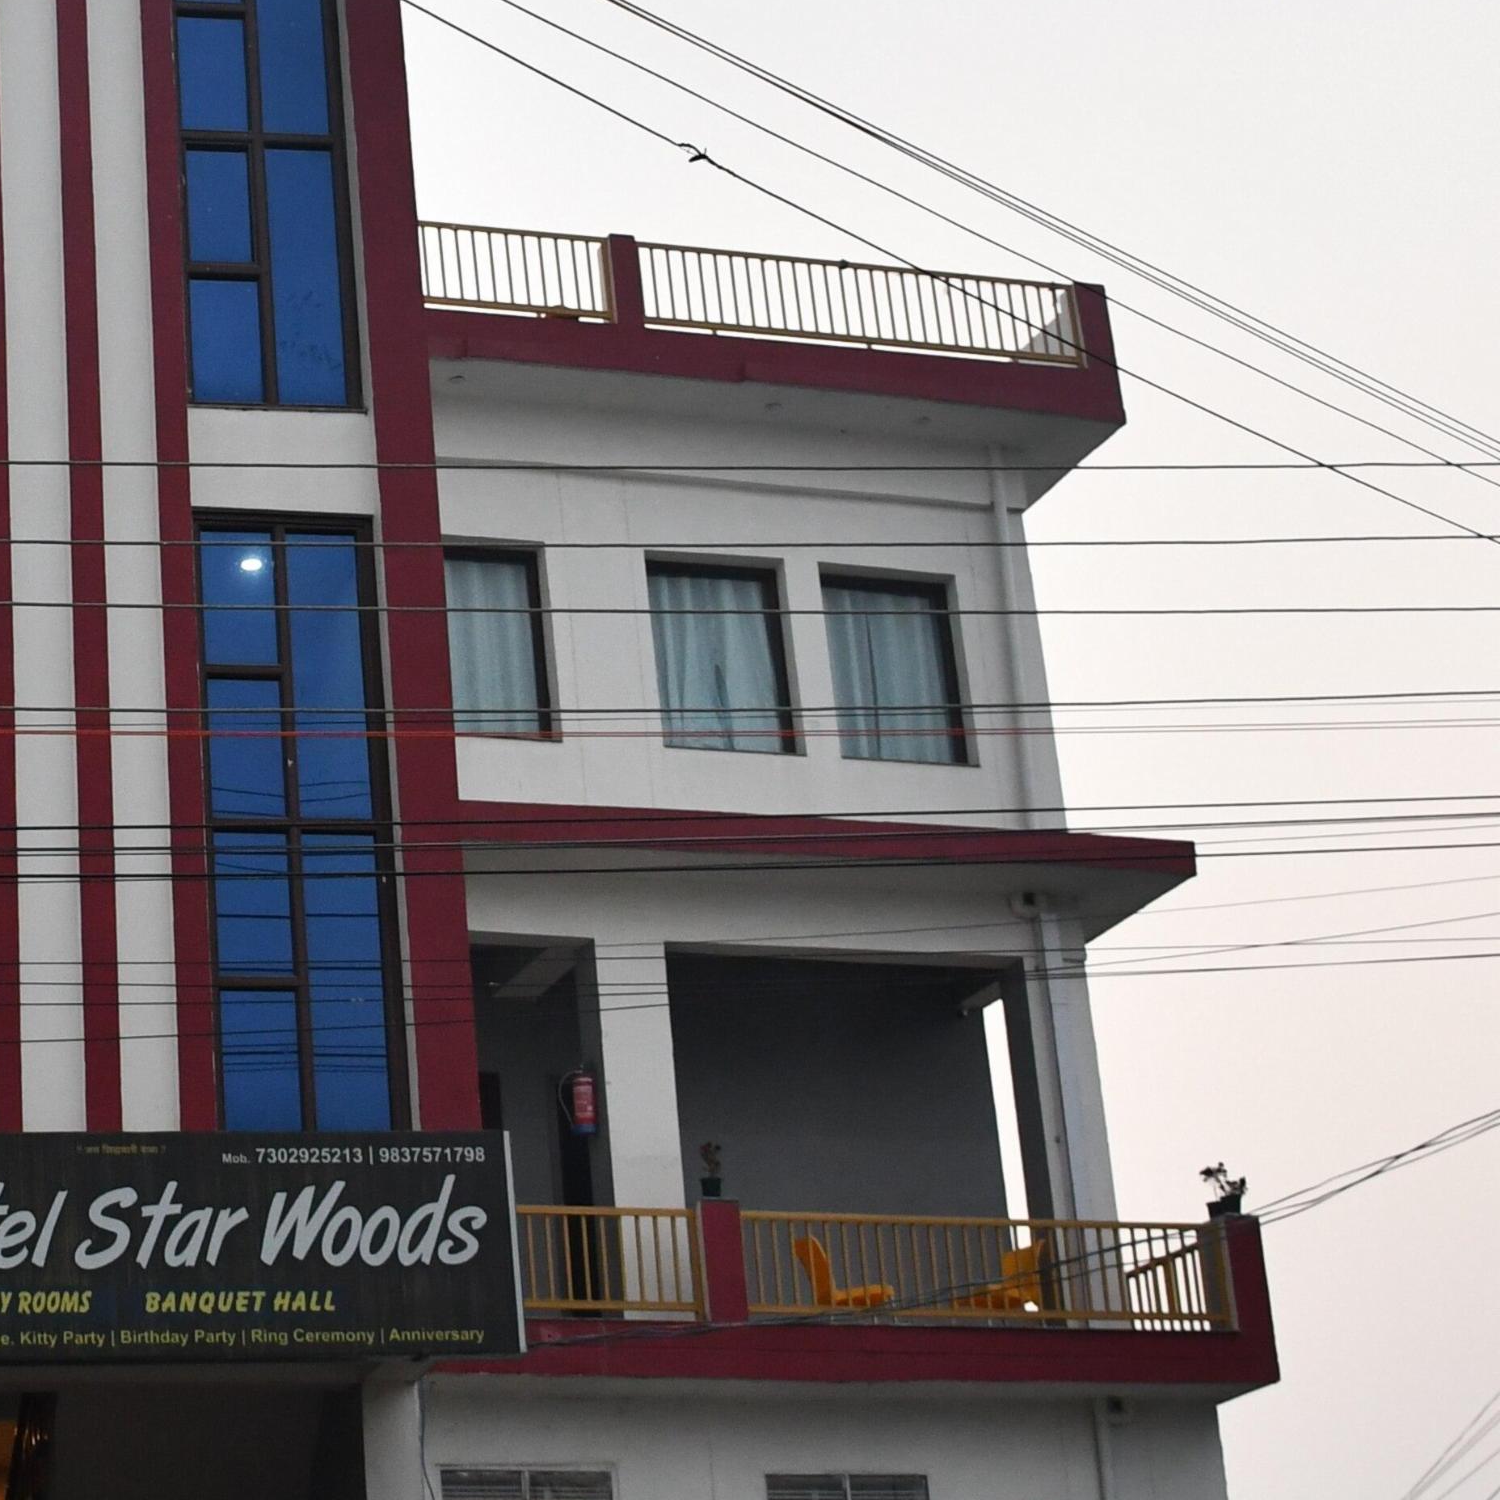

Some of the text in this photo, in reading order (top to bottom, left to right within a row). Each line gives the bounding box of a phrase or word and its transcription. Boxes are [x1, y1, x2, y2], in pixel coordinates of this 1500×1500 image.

[222, 1152, 251, 1165] Mob.
[255, 1147, 363, 1165] 7302925213
[379, 1146, 486, 1164] 9837571798
[74, 1180, 249, 1270] Star
[260, 1174, 488, 1268] Woods
[18, 1290, 92, 1314] ROOMS
[145, 1290, 336, 1315] BANQUET HALL
[20, 1331, 58, 1349] Kitty
[63, 1331, 105, 1349] Party
[120, 1329, 189, 1348] Birthday
[194, 1329, 237, 1348] Party
[252, 1328, 288, 1347] Ring
[292, 1328, 375, 1346] Ceremony
[389, 1326, 485, 1345] Anniversary
